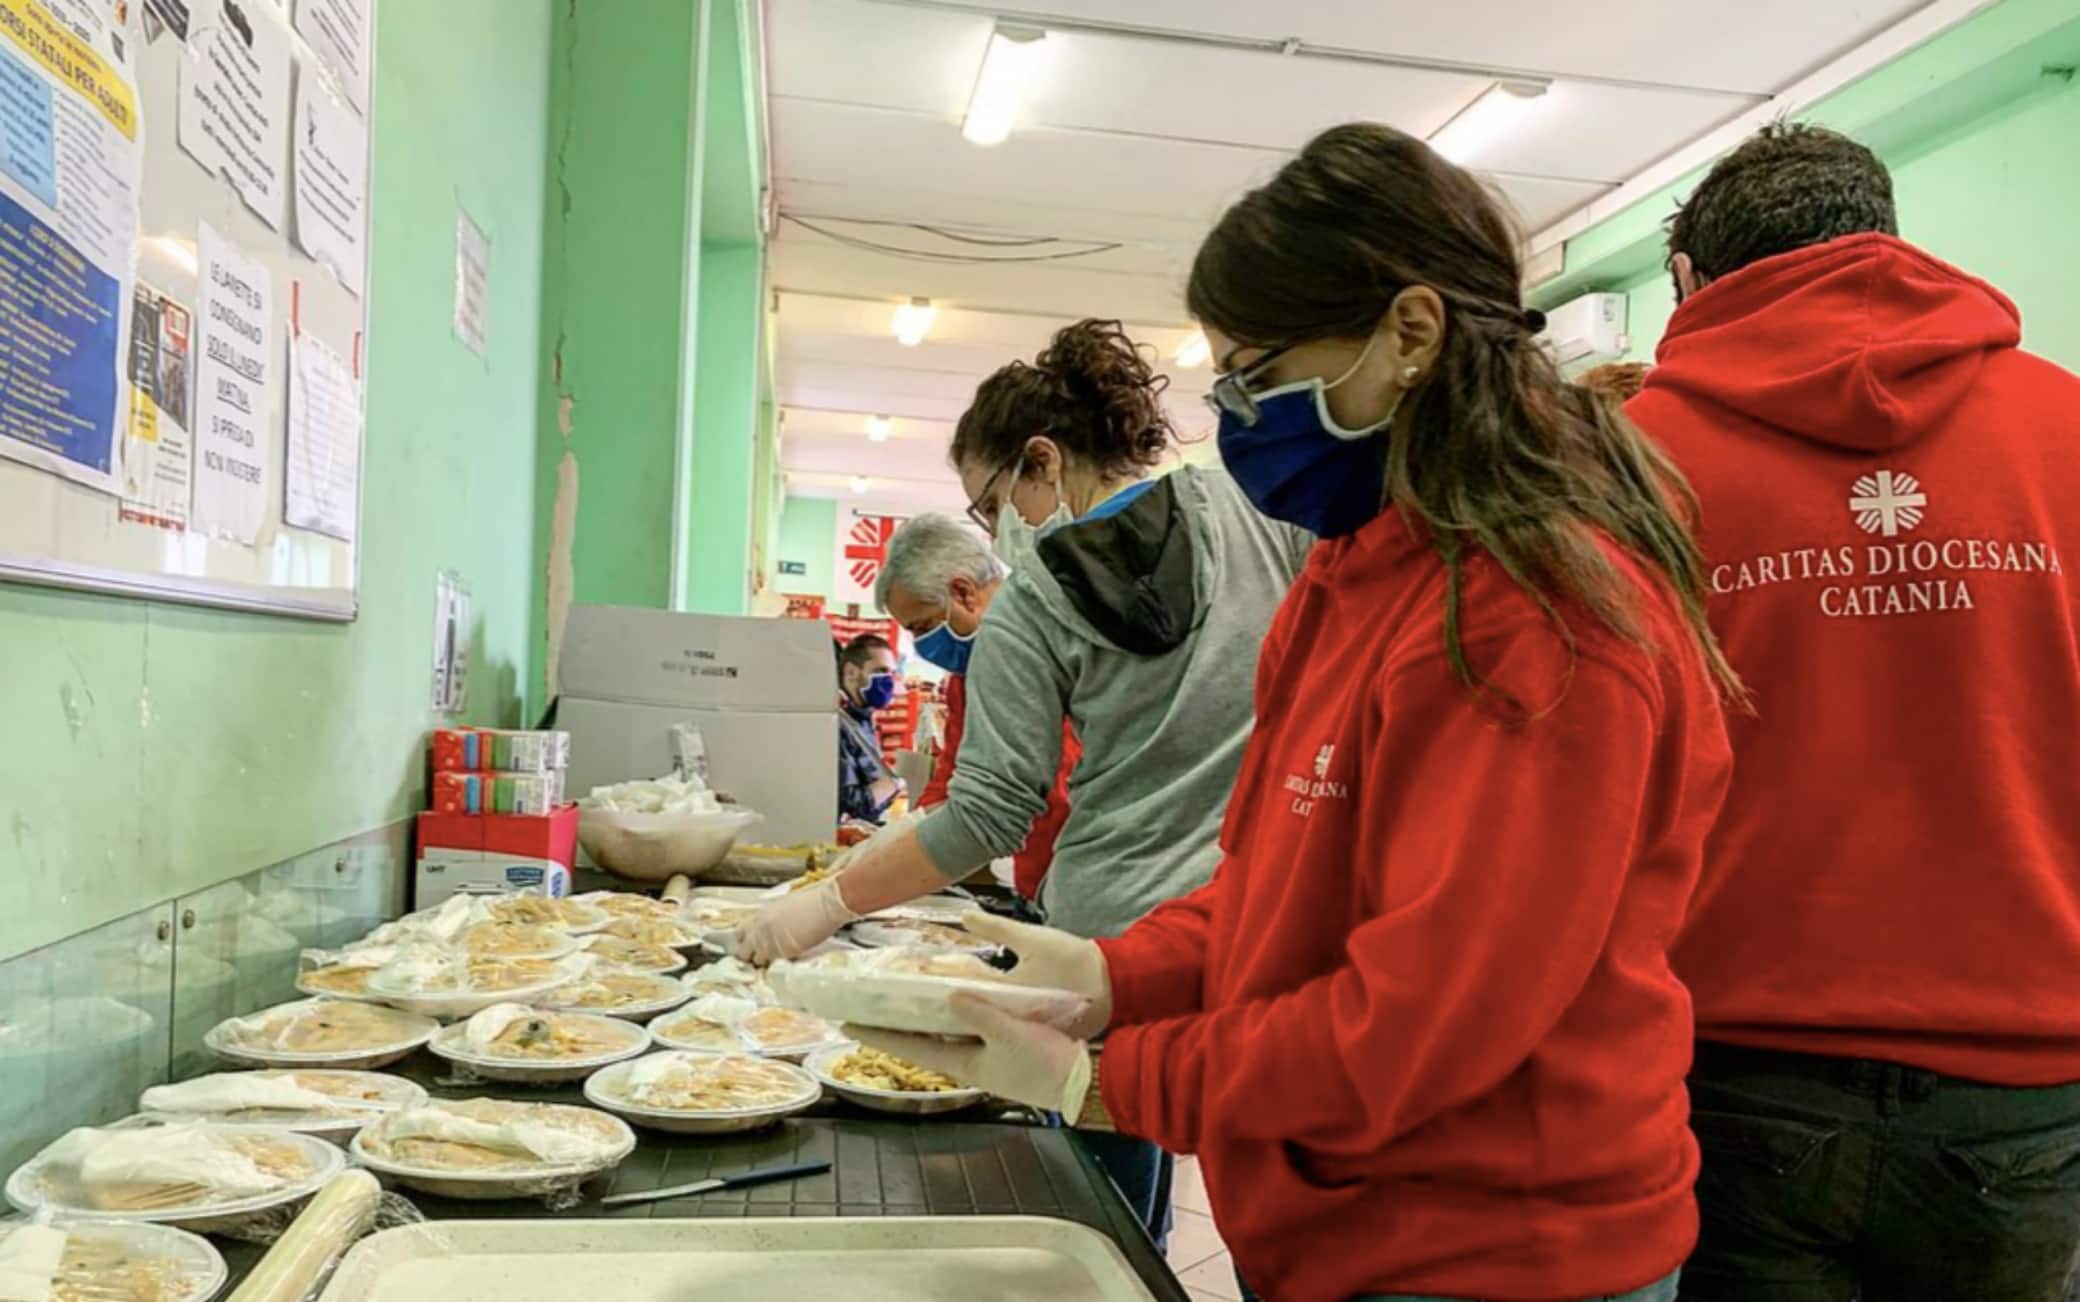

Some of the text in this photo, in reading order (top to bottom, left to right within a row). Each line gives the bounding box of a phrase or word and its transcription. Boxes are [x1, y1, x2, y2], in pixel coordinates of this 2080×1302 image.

[1712, 540, 2063, 593] CARITAS DIOCESANA
[1820, 581, 1974, 617] CATANIA
